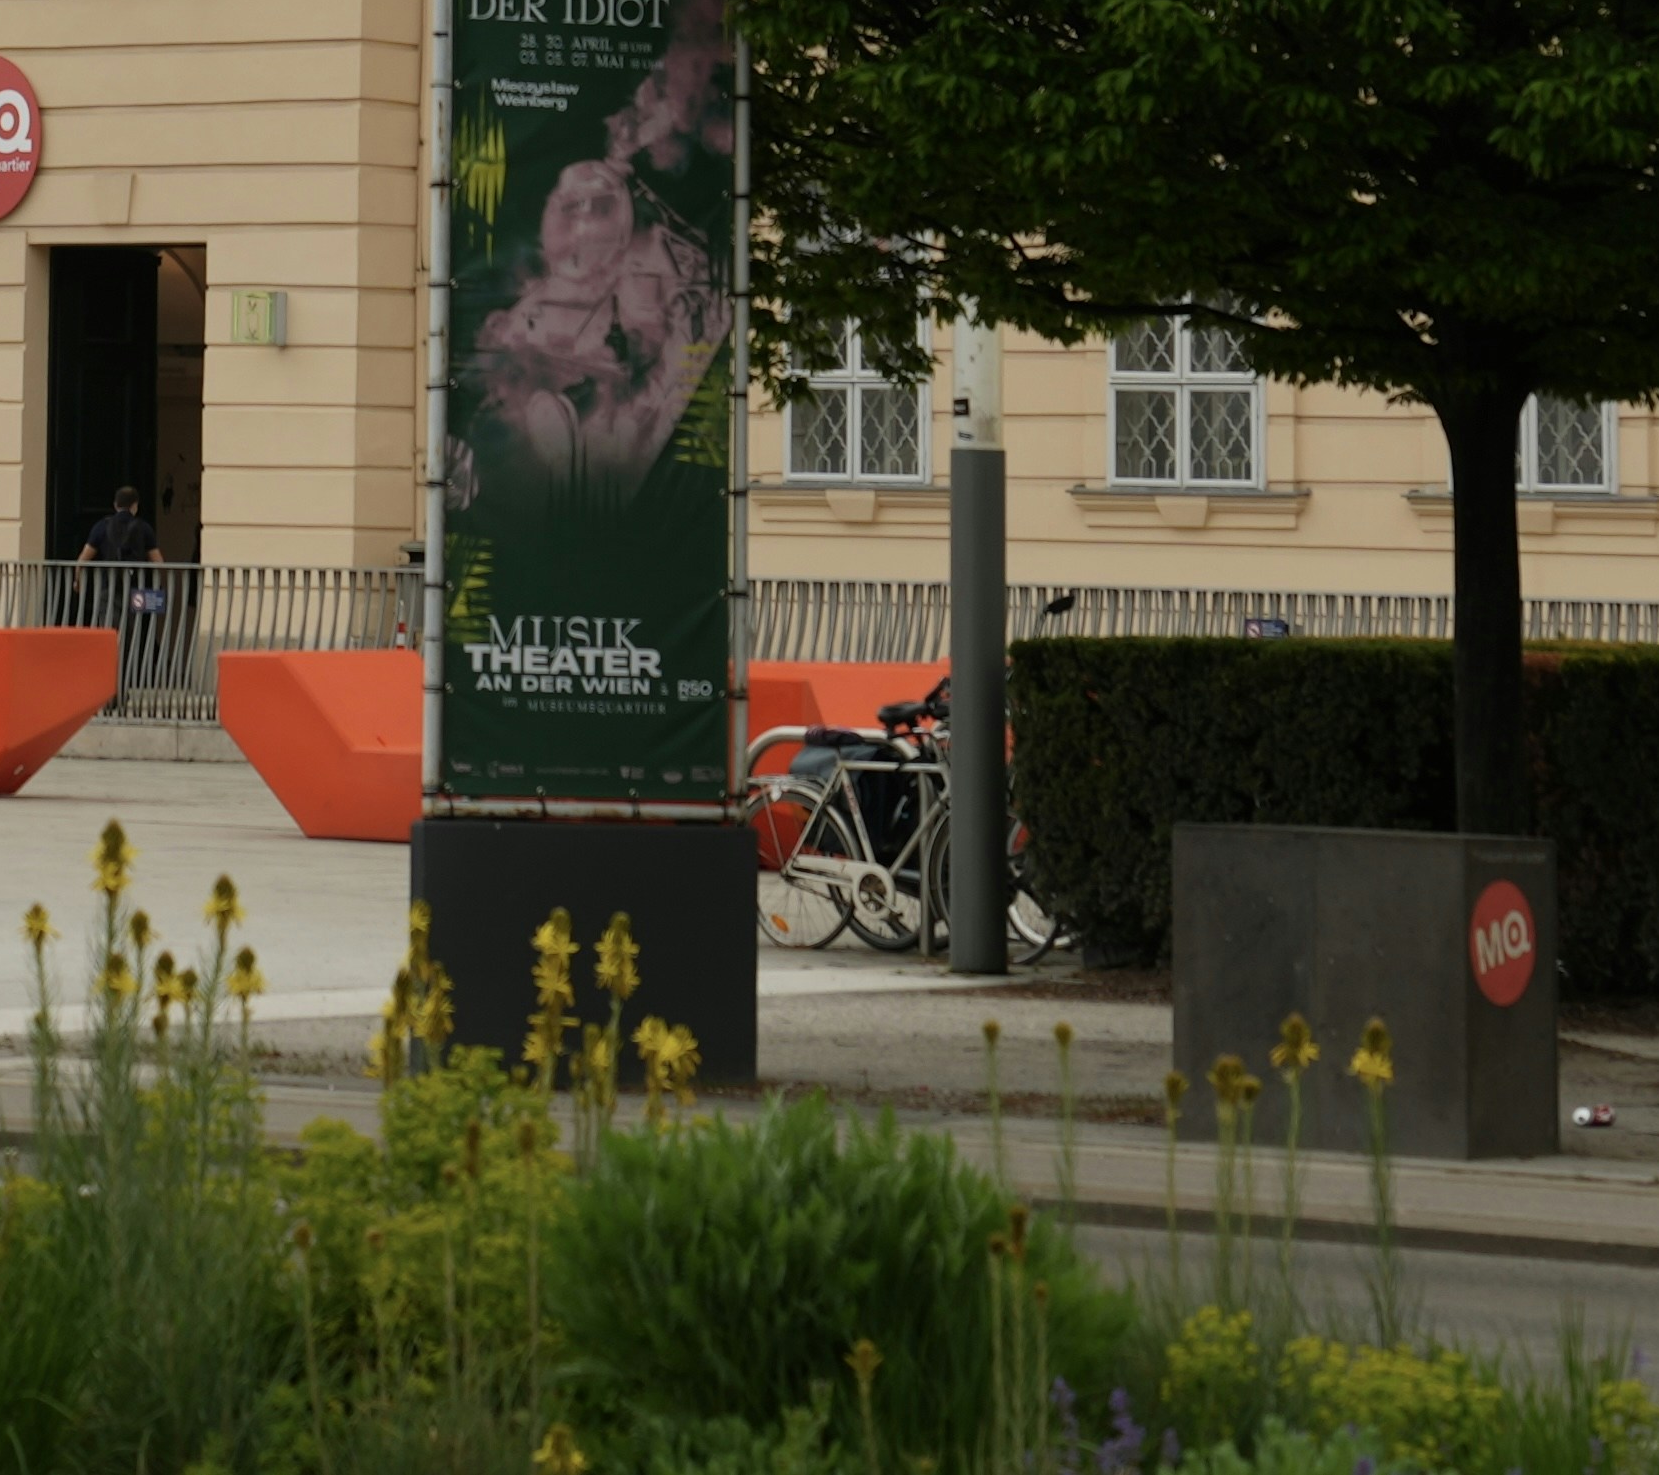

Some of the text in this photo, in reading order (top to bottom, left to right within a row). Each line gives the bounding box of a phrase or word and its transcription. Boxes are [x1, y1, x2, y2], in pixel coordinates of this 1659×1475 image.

[594, 53, 625, 70] MAI
[494, 91, 569, 113] Weinberg
[487, 614, 642, 655] MUSIK
[463, 642, 663, 678] THEATER
[475, 673, 512, 692] AN
[521, 675, 573, 694] DER
[581, 677, 650, 695] WIEN
[527, 700, 667, 715] MUSEUMSQUARTIER
[1475, 909, 1531, 975] MQ
